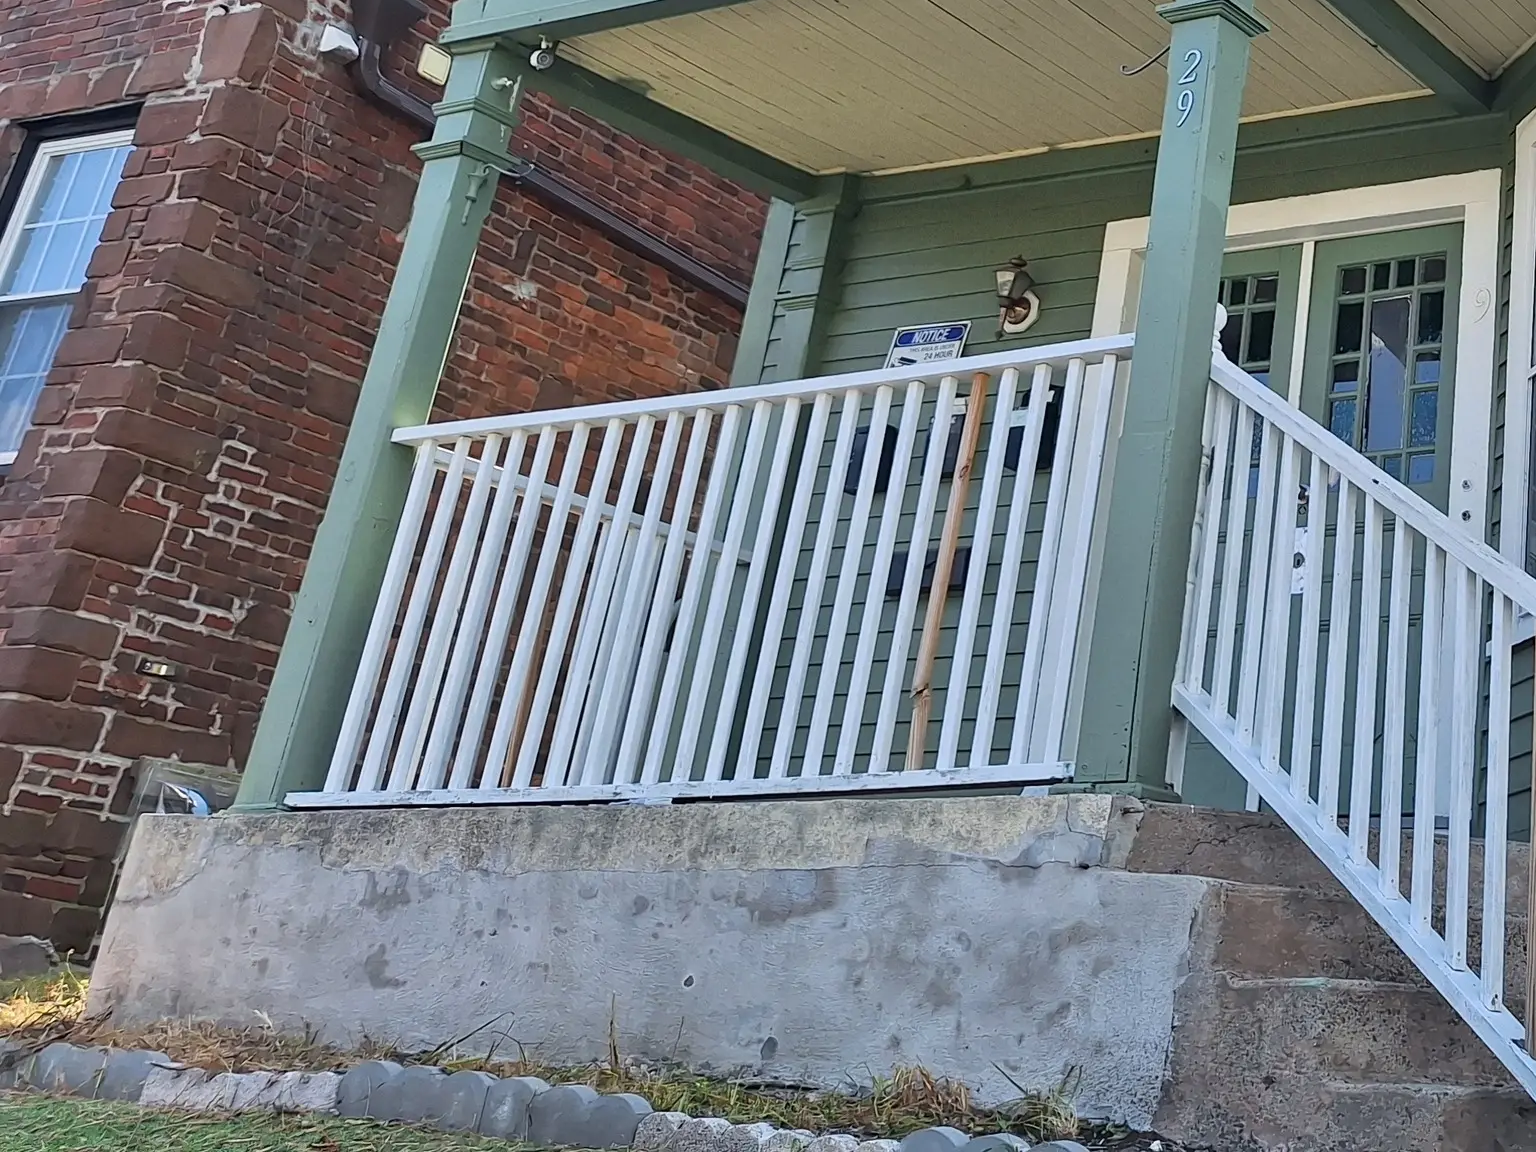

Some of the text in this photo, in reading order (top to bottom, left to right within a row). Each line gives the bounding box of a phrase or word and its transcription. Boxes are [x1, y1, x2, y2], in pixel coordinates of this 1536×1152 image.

[1177, 48, 1203, 128] 29
[1473, 287, 1492, 324] 9
[911, 328, 951, 344] NOTICE
[923, 350, 954, 360] 24 HOUR
